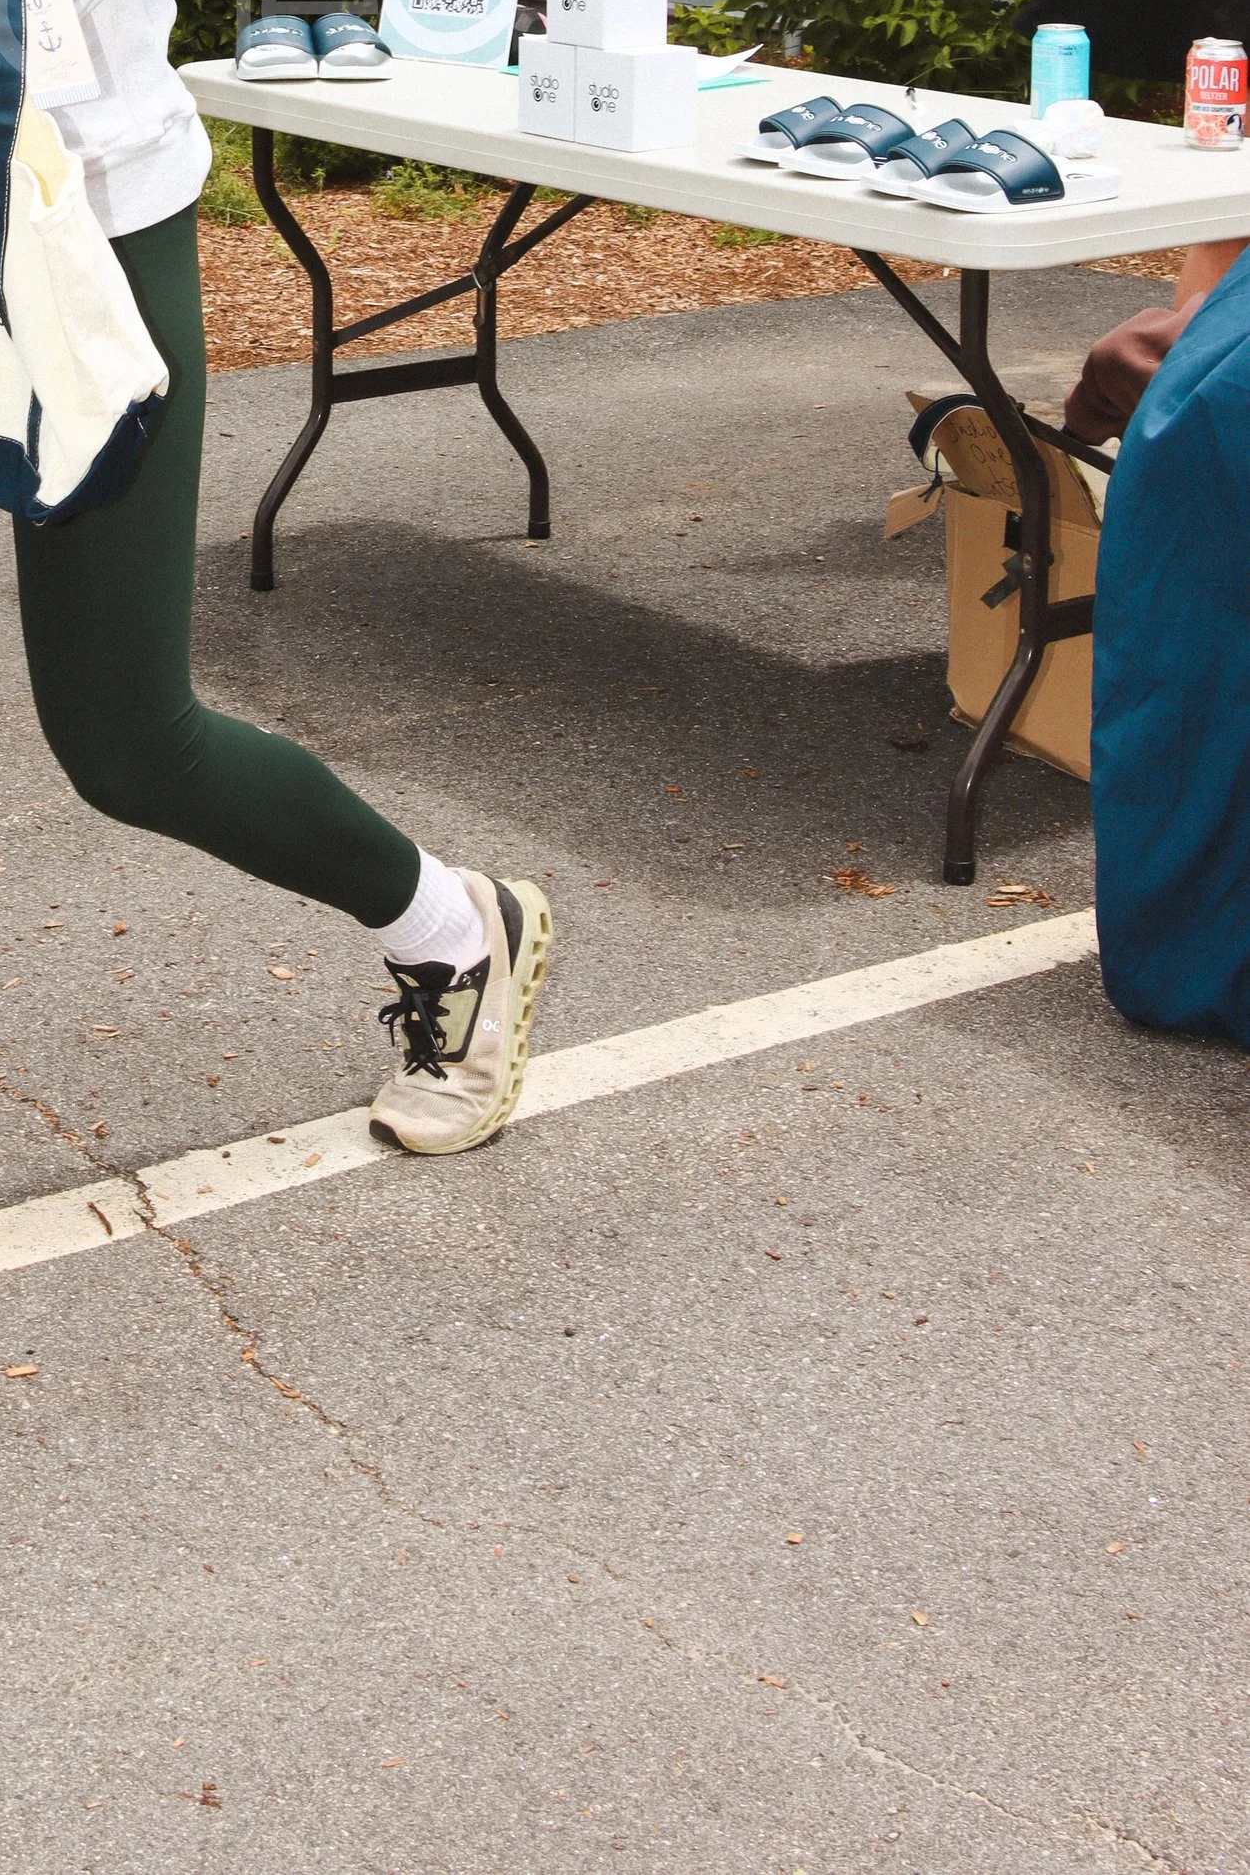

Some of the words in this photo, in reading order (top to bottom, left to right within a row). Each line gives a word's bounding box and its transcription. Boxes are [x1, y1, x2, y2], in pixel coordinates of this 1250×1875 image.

[530, 73, 559, 90] studio
[1190, 64, 1240, 92] POLAR
[588, 82, 619, 99] studio
